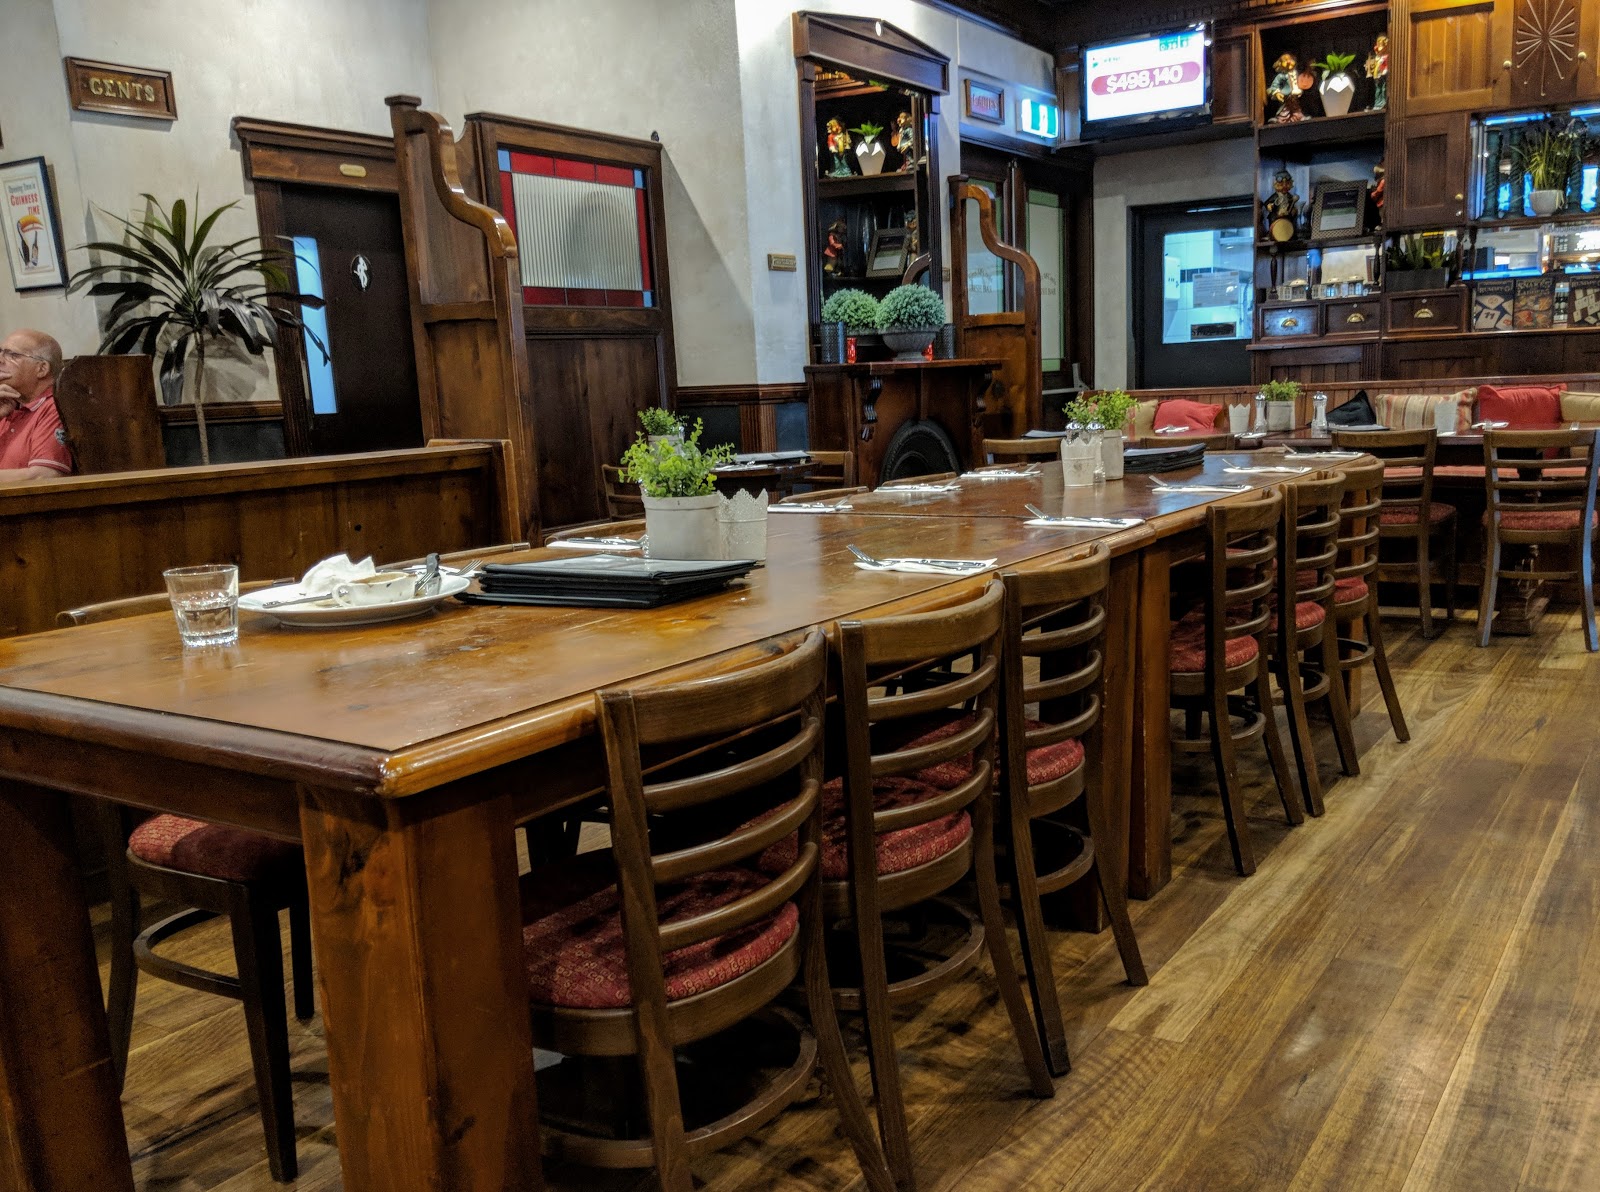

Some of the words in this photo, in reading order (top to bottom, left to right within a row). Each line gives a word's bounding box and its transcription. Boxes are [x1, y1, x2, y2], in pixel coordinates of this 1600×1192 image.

[1106, 65, 1183, 94] $498,140
[89, 77, 155, 102] GENTS
[11, 192, 38, 206] GUINNESS
[28, 205, 40, 215] TIME
